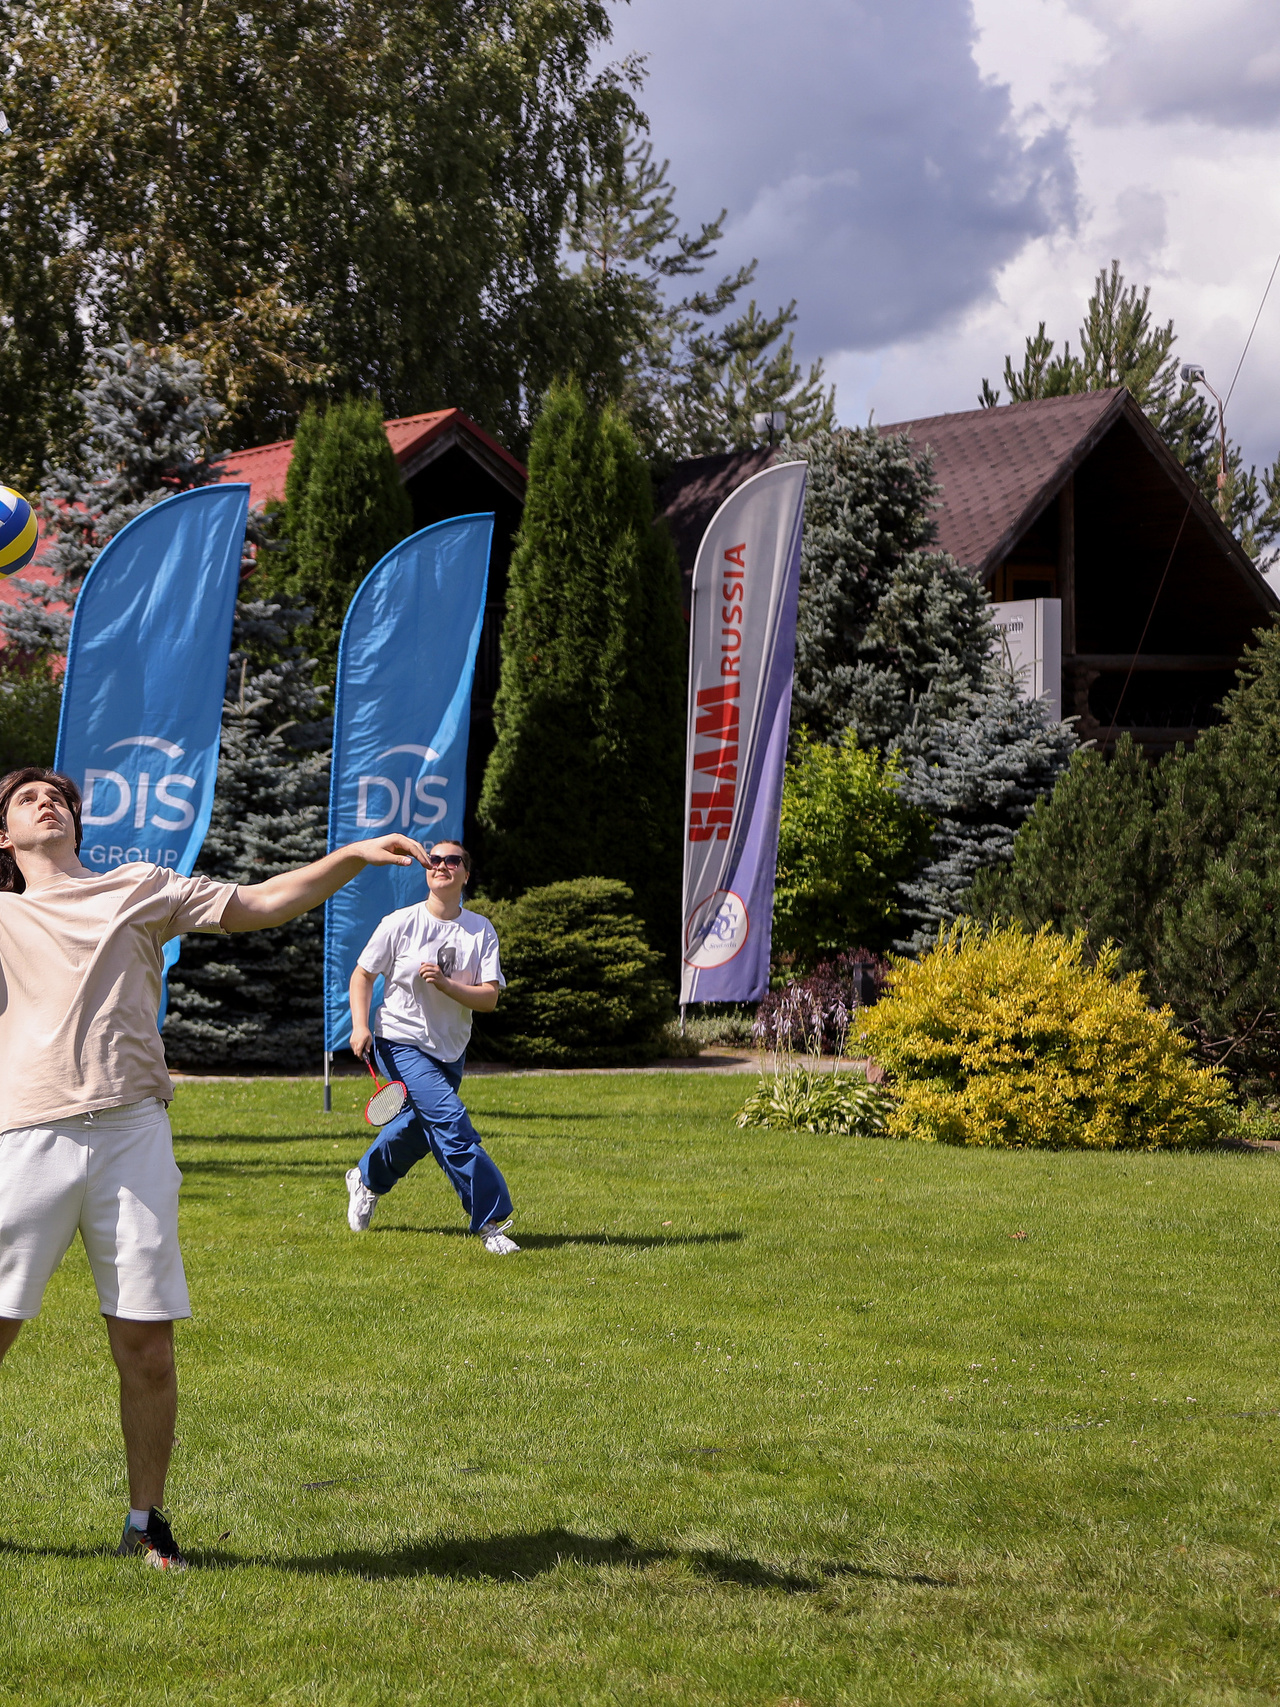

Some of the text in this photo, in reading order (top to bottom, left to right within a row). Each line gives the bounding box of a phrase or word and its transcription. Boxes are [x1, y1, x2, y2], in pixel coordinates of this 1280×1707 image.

[688, 543, 746, 842] SLAM RUSSIA
[80, 768, 197, 831] DIS
[356, 775, 449, 828] DIS
[89, 844, 178, 867] GROUP
